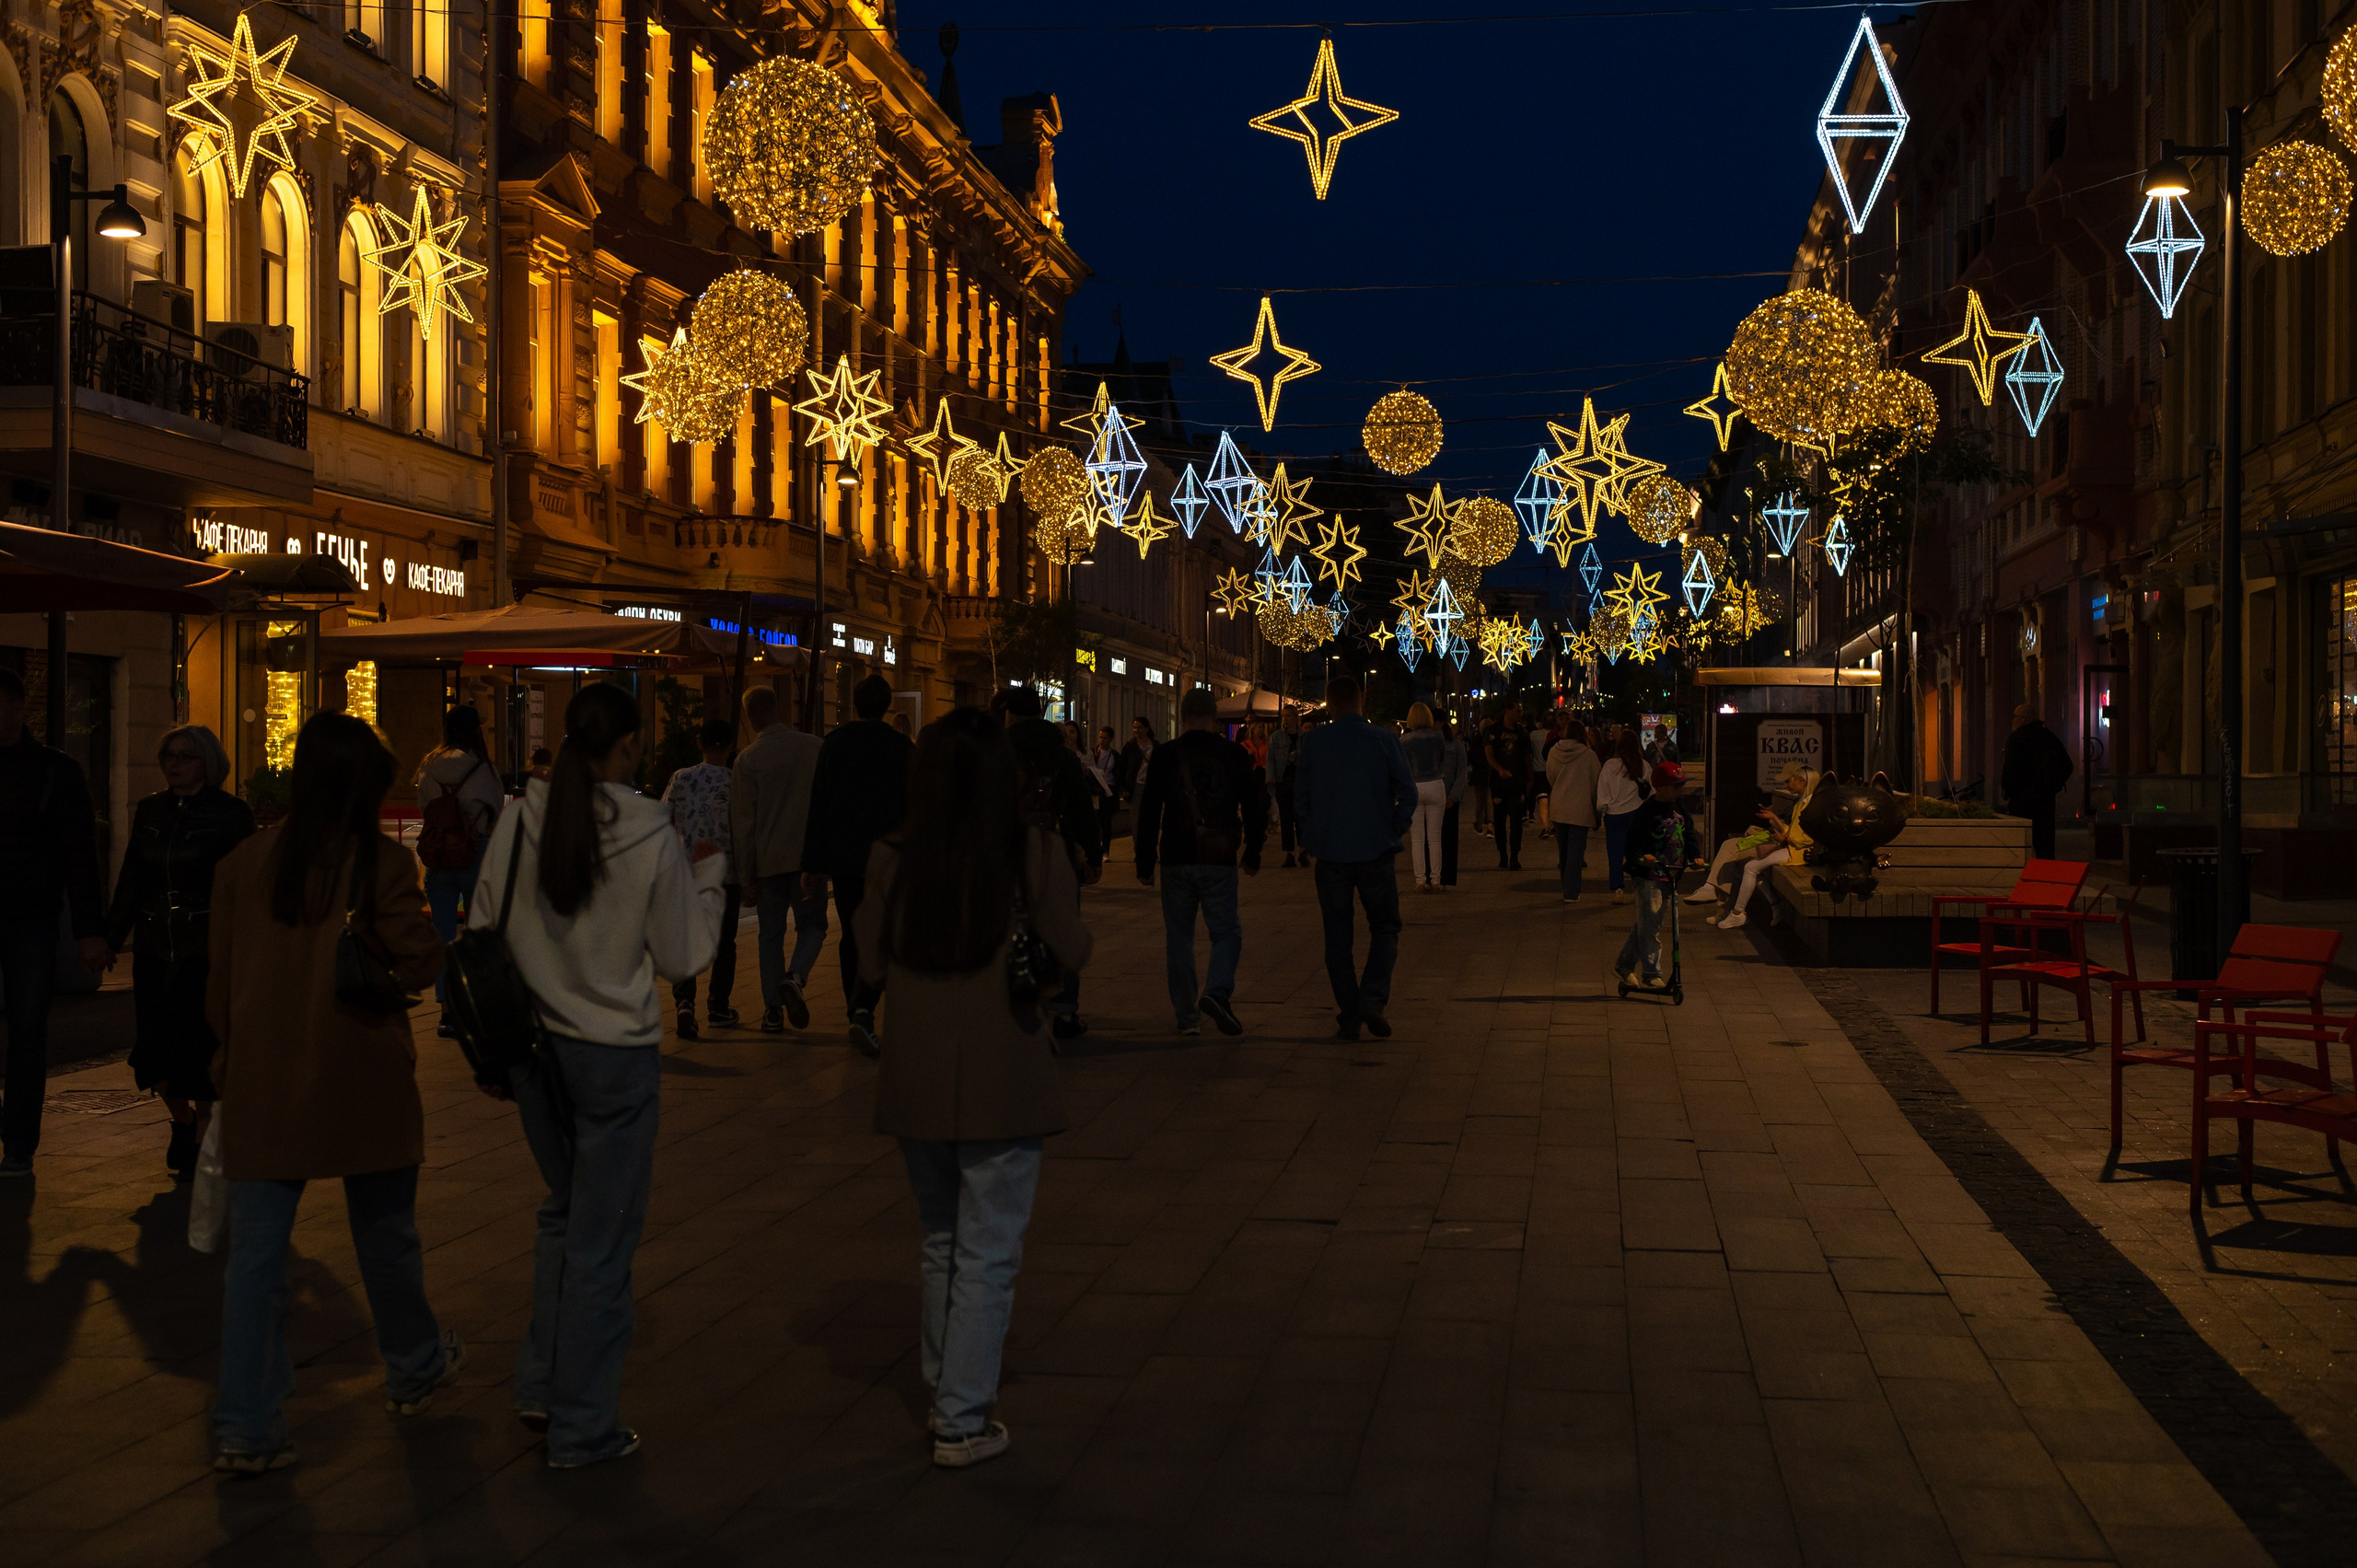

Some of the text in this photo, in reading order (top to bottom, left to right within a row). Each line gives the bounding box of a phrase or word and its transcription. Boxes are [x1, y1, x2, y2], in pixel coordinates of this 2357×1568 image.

[408, 562, 464, 598] КАФЕ-ПЕКАРНЯ
[614, 607, 646, 619] АЛОН
[1760, 737, 1819, 754] КВАС
